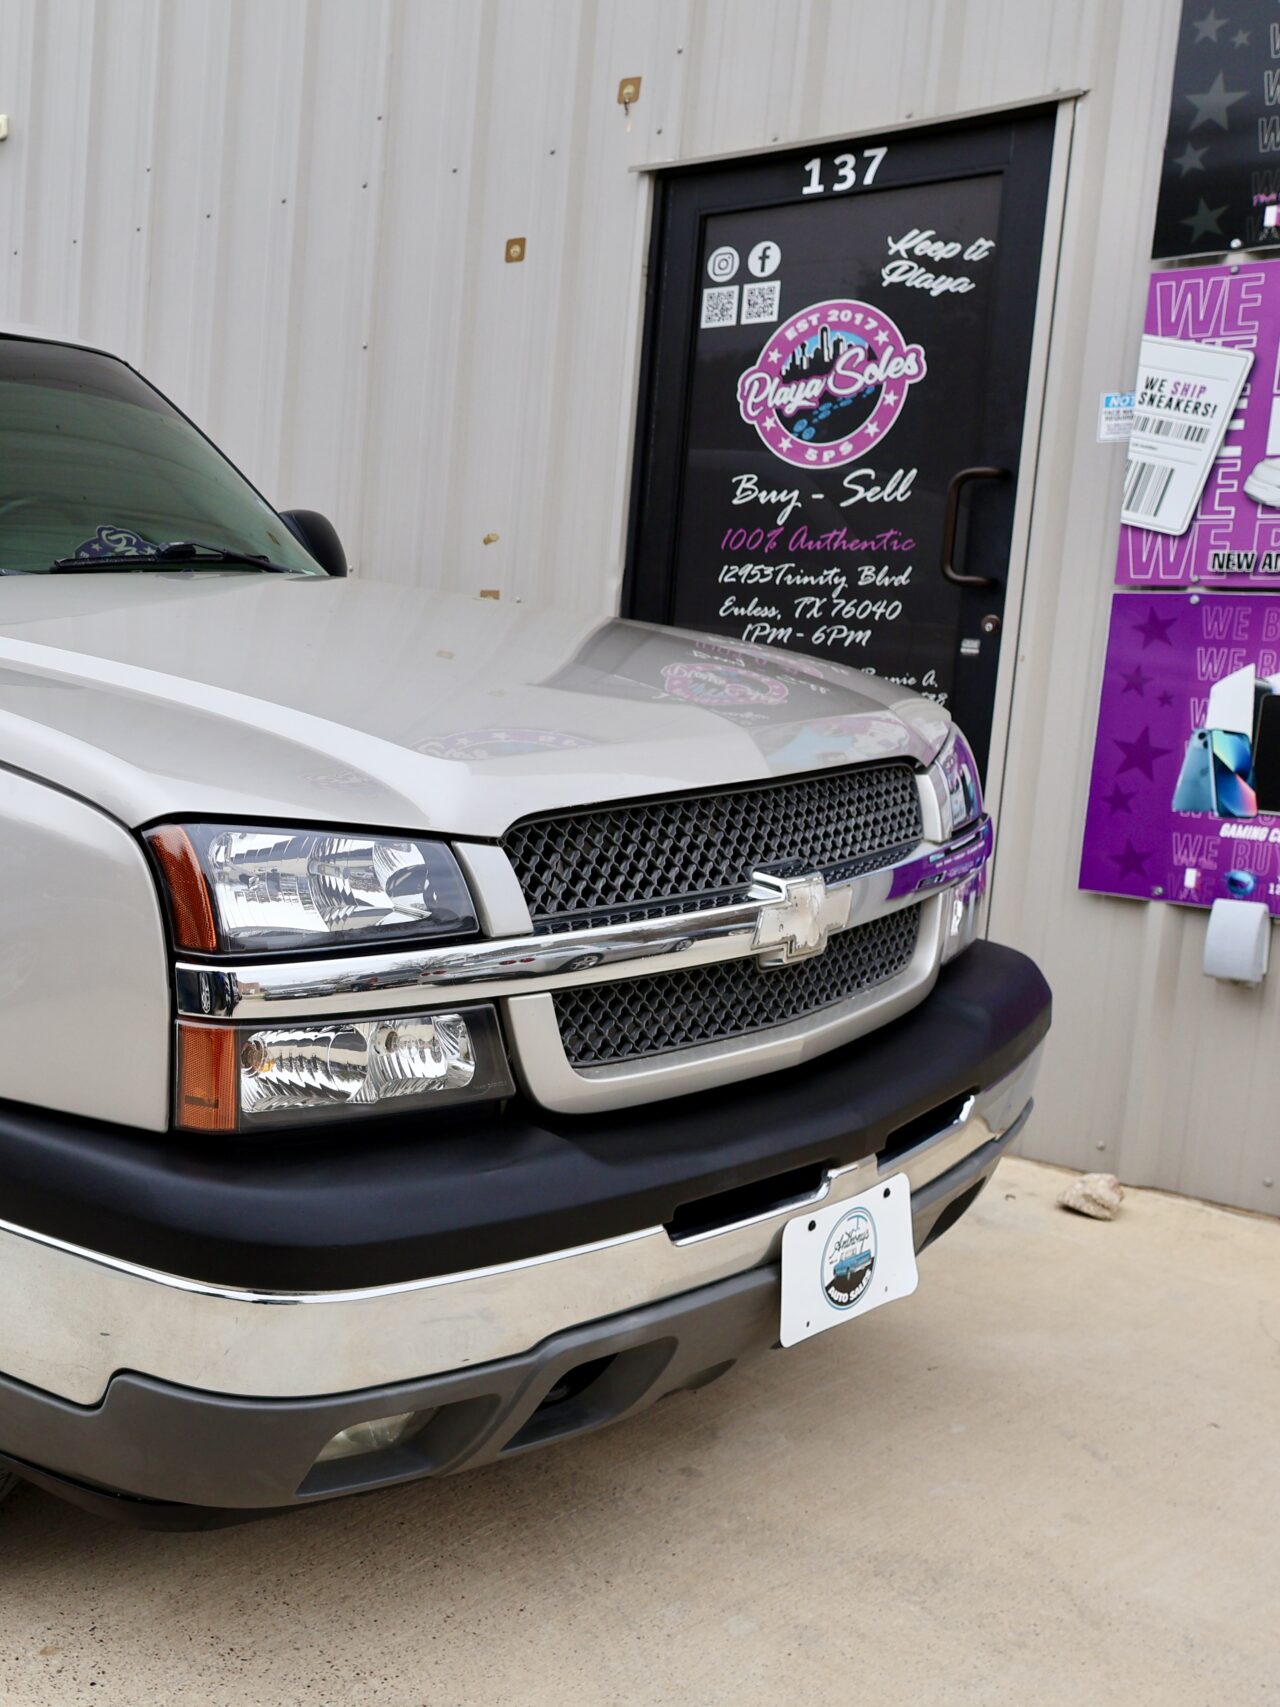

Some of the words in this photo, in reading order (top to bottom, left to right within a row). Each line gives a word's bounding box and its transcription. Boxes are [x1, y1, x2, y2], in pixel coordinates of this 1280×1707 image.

[802, 147, 889, 195] 137
[887, 228, 962, 262] Keep
[963, 237, 995, 261] it
[881, 259, 976, 297] Playa
[1156, 272, 1266, 338] WE
[784, 313, 820, 341] EST
[827, 309, 879, 331] 2017
[743, 372, 826, 416] Playa
[826, 345, 919, 395] Soles
[1144, 376, 1168, 393] WE
[1171, 381, 1207, 399] SHIP
[1138, 392, 1218, 418] SNEAKERS!
[732, 474, 802, 526] Buy
[840, 468, 918, 507] Sell
[721, 526, 784, 553] 100%
[788, 525, 916, 552] Authentic
[857, 565, 912, 586] Blvd
[1212, 552, 1255, 570] NEW
[719, 596, 782, 620] Euless,
[794, 597, 827, 618] TX
[831, 598, 902, 621] 76040
[1202, 605, 1252, 640] WE
[742, 623, 792, 643] 1PM
[811, 625, 872, 647] 6PM
[1219, 822, 1270, 842] GAMING
[828, 1286, 849, 1303] AUTO
[849, 1268, 872, 1300] SALES
